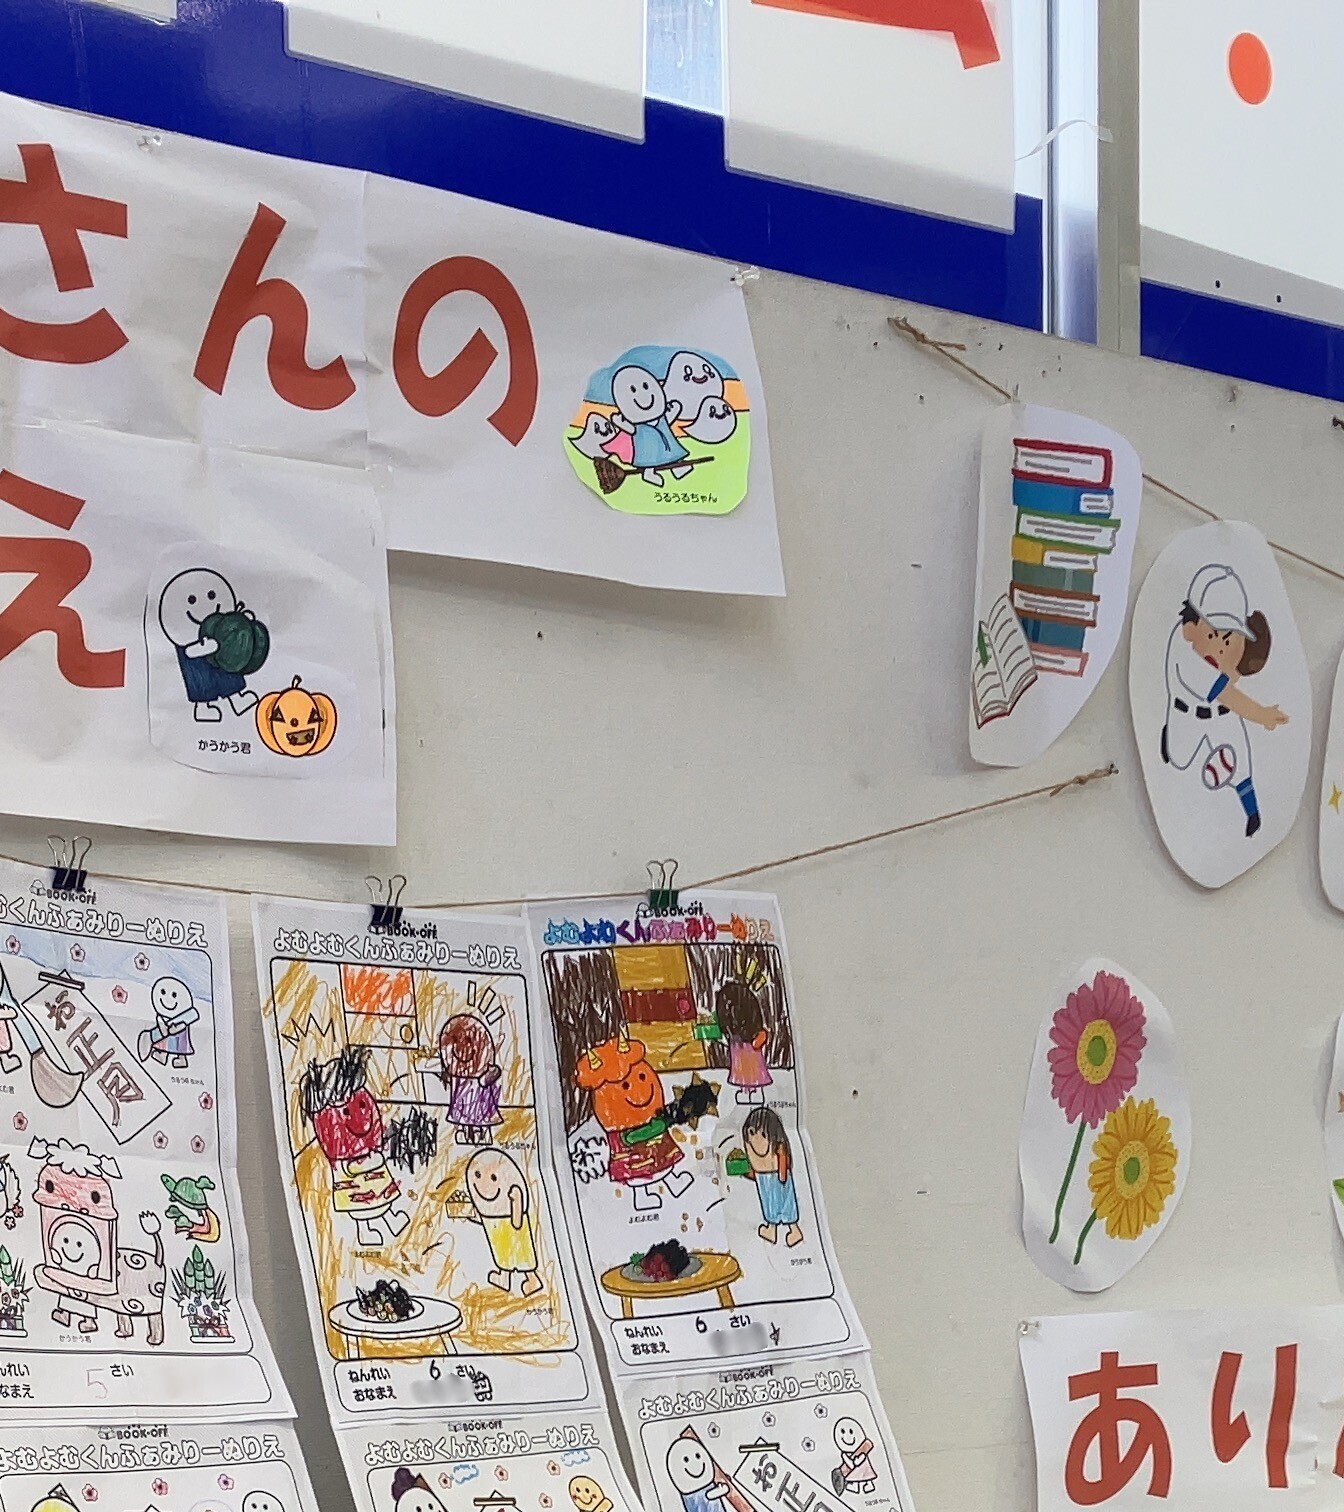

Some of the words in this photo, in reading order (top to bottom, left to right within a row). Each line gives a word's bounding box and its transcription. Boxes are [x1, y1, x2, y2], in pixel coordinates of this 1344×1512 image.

[653, 491, 718, 504] うるうるちゃん
[197, 738, 252, 755] かうかう君
[273, 927, 522, 970] よむよむくんふぁみりーぬりえ
[43, 989, 144, 1127] お正月
[624, 1325, 663, 1338] ねんれい
[695, 1316, 707, 1333] 6
[109, 1364, 135, 1378] さい
[347, 1367, 391, 1382] ねんれい
[429, 1359, 442, 1381] 6
[353, 1386, 397, 1401] おなまえ
[638, 1368, 861, 1420] よむよむくんふぁみりーぬりえ
[365, 1423, 599, 1466] よむよむくんふぁみりーぬりえ
